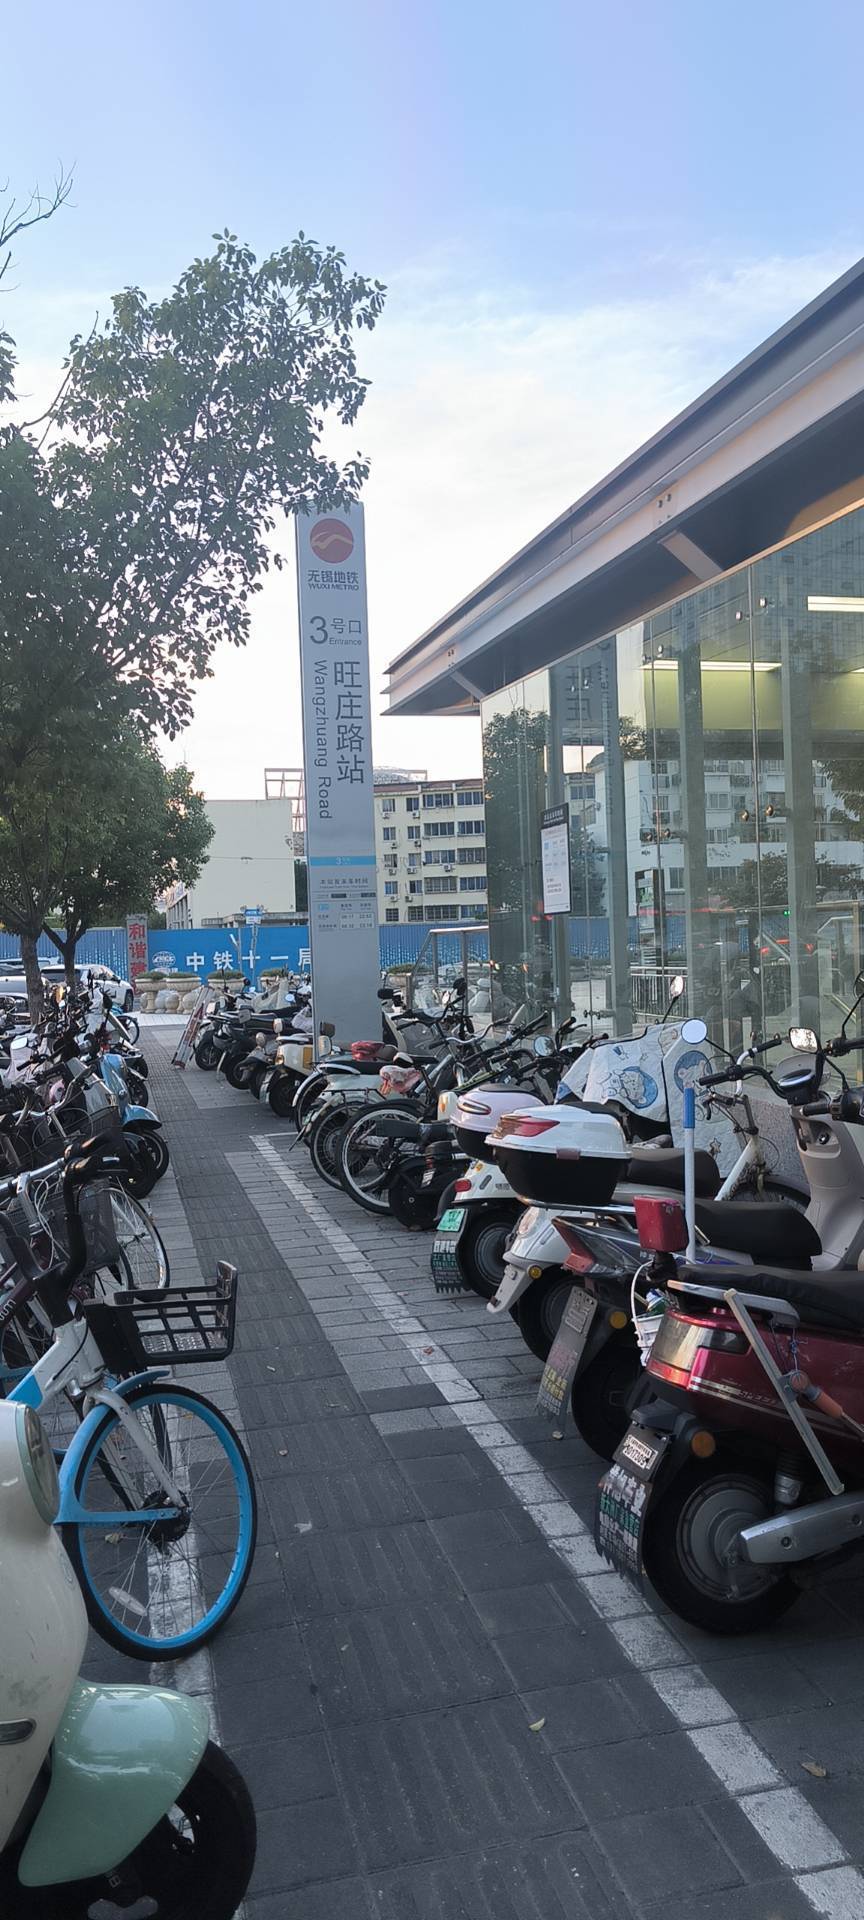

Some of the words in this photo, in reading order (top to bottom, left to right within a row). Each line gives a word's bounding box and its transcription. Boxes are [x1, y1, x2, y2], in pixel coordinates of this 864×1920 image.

[307, 569, 359, 584] 无锡地铁
[307, 583, 331, 591] WUXI
[328, 637, 362, 646] Entrance
[312, 659, 329, 768] Wangzhuang
[333, 661, 365, 784] 旺庄路站
[318, 775, 332, 820] Road
[129, 922, 147, 993] 和谐建
[186, 948, 311, 973] 中铁十一局
